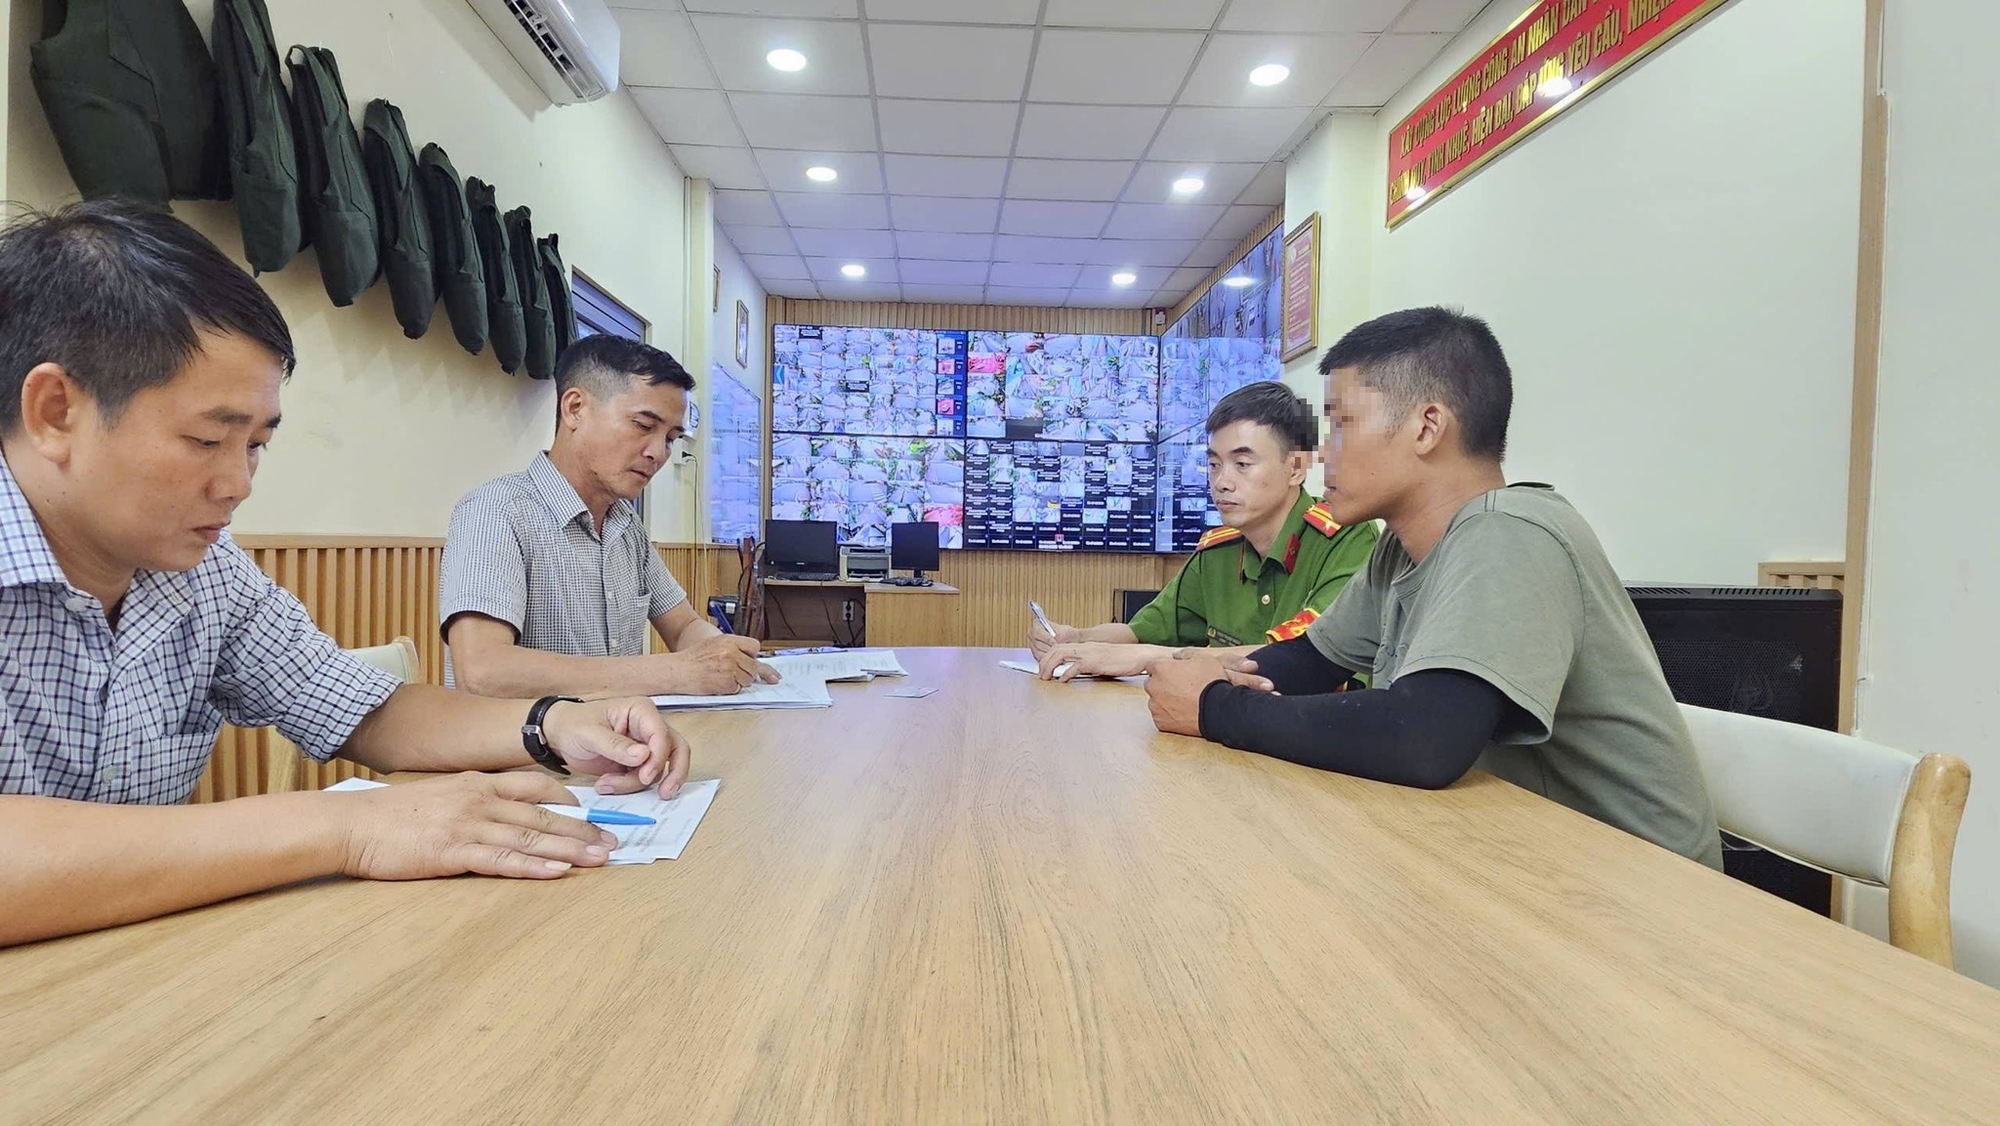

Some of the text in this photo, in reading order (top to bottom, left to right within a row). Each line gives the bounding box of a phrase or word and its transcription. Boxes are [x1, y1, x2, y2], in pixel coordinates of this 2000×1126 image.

[1471, 105, 1495, 147] HIỆN
[1567, 31, 1592, 77] YÊU
[1593, 4, 1624, 58] CẦU,
[1482, 47, 1509, 91] CÔNG
[1510, 30, 1527, 71] AN
[1527, 3, 1559, 57] NHÂN
